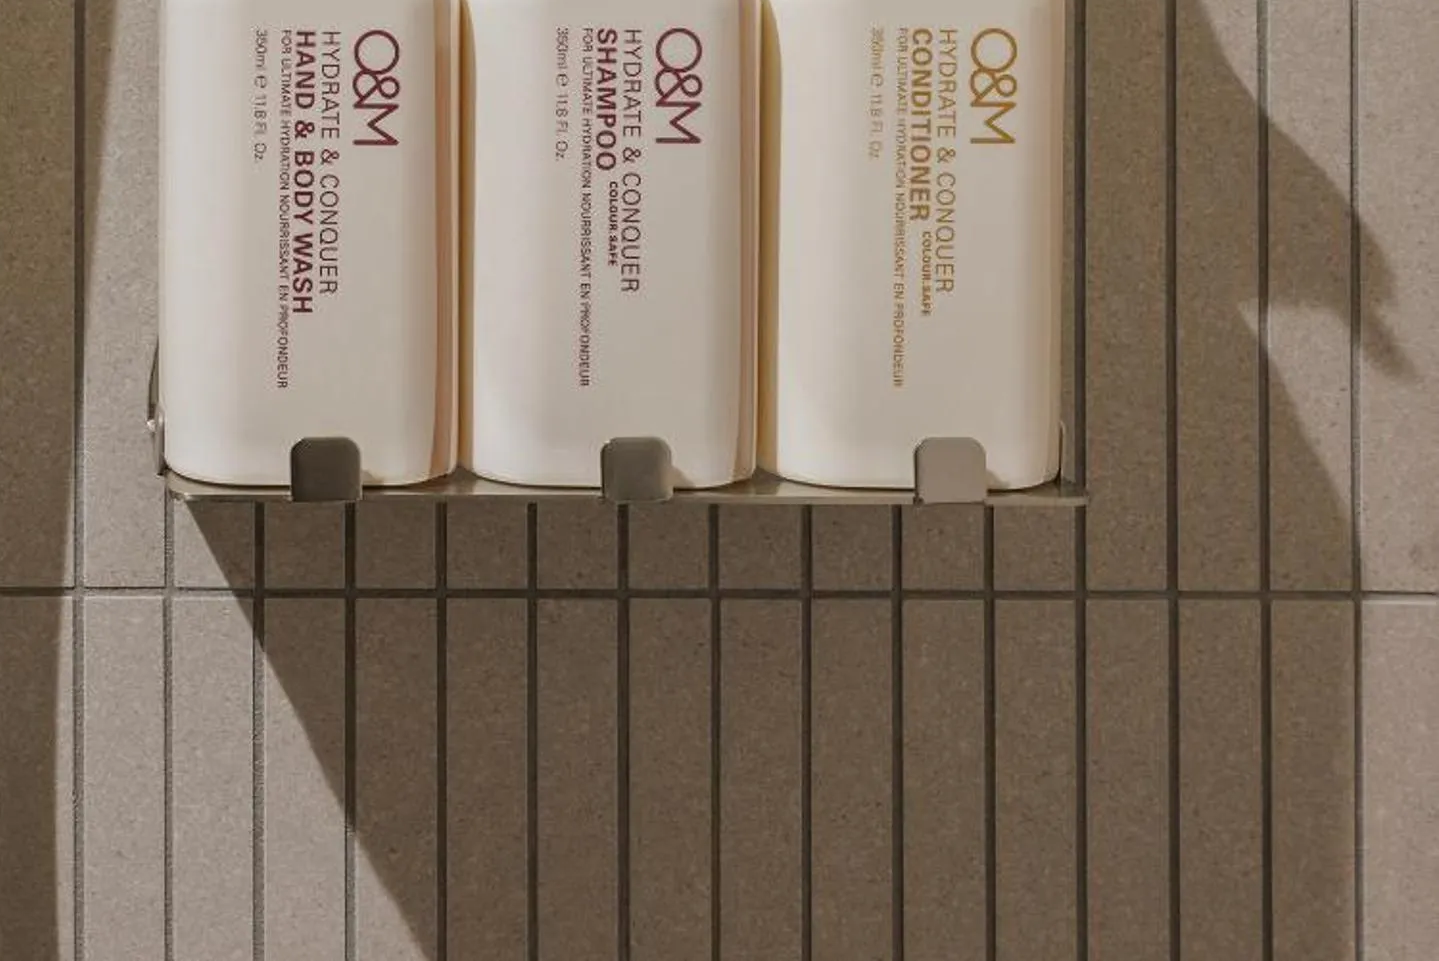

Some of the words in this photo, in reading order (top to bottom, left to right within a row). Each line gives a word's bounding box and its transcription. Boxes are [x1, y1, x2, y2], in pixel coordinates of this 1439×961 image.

[255, 29, 268, 69] 350ml
[281, 30, 292, 54] FOR
[295, 30, 315, 109] HAND
[556, 28, 569, 69] 350ml
[582, 28, 592, 52] FOR
[897, 28, 908, 52] FOR
[280, 58, 291, 116] ULTIMATE
[321, 31, 341, 139] HYDRATE
[352, 30, 400, 146] O&M
[581, 56, 592, 114] ULTIMATE
[596, 28, 617, 171] SHAMPOO
[623, 29, 642, 137] HYDRATE
[654, 28, 703, 145] O&M
[896, 57, 907, 114] ULTIMATE
[937, 29, 957, 138] HYDRATE
[970, 28, 1018, 145] O&M
[279, 120, 290, 191] HYDRATION
[294, 120, 314, 139] &
[320, 148, 339, 165] &
[581, 118, 592, 189] HYDRATION
[622, 147, 640, 164] &
[895, 118, 906, 188] HYDRATION
[910, 29, 932, 220] CONDITIONER
[937, 148, 955, 164] &
[293, 151, 314, 225] BODY
[278, 195, 290, 279] NOURRISSANT
[319, 174, 338, 294] CONQUER
[580, 193, 591, 278] NOURRISSANT
[621, 173, 640, 292] CONQUER
[894, 193, 905, 279] NOURRISSANT
[935, 172, 955, 292] CONQUER
[278, 285, 289, 301] EN
[292, 233, 313, 313] WASH
[580, 284, 590, 299] EN
[893, 283, 904, 299] EN
[277, 305, 288, 389] PROFONDEUR
[579, 303, 590, 386] PROFONDEUR
[893, 303, 903, 387] PROFONDEUR
